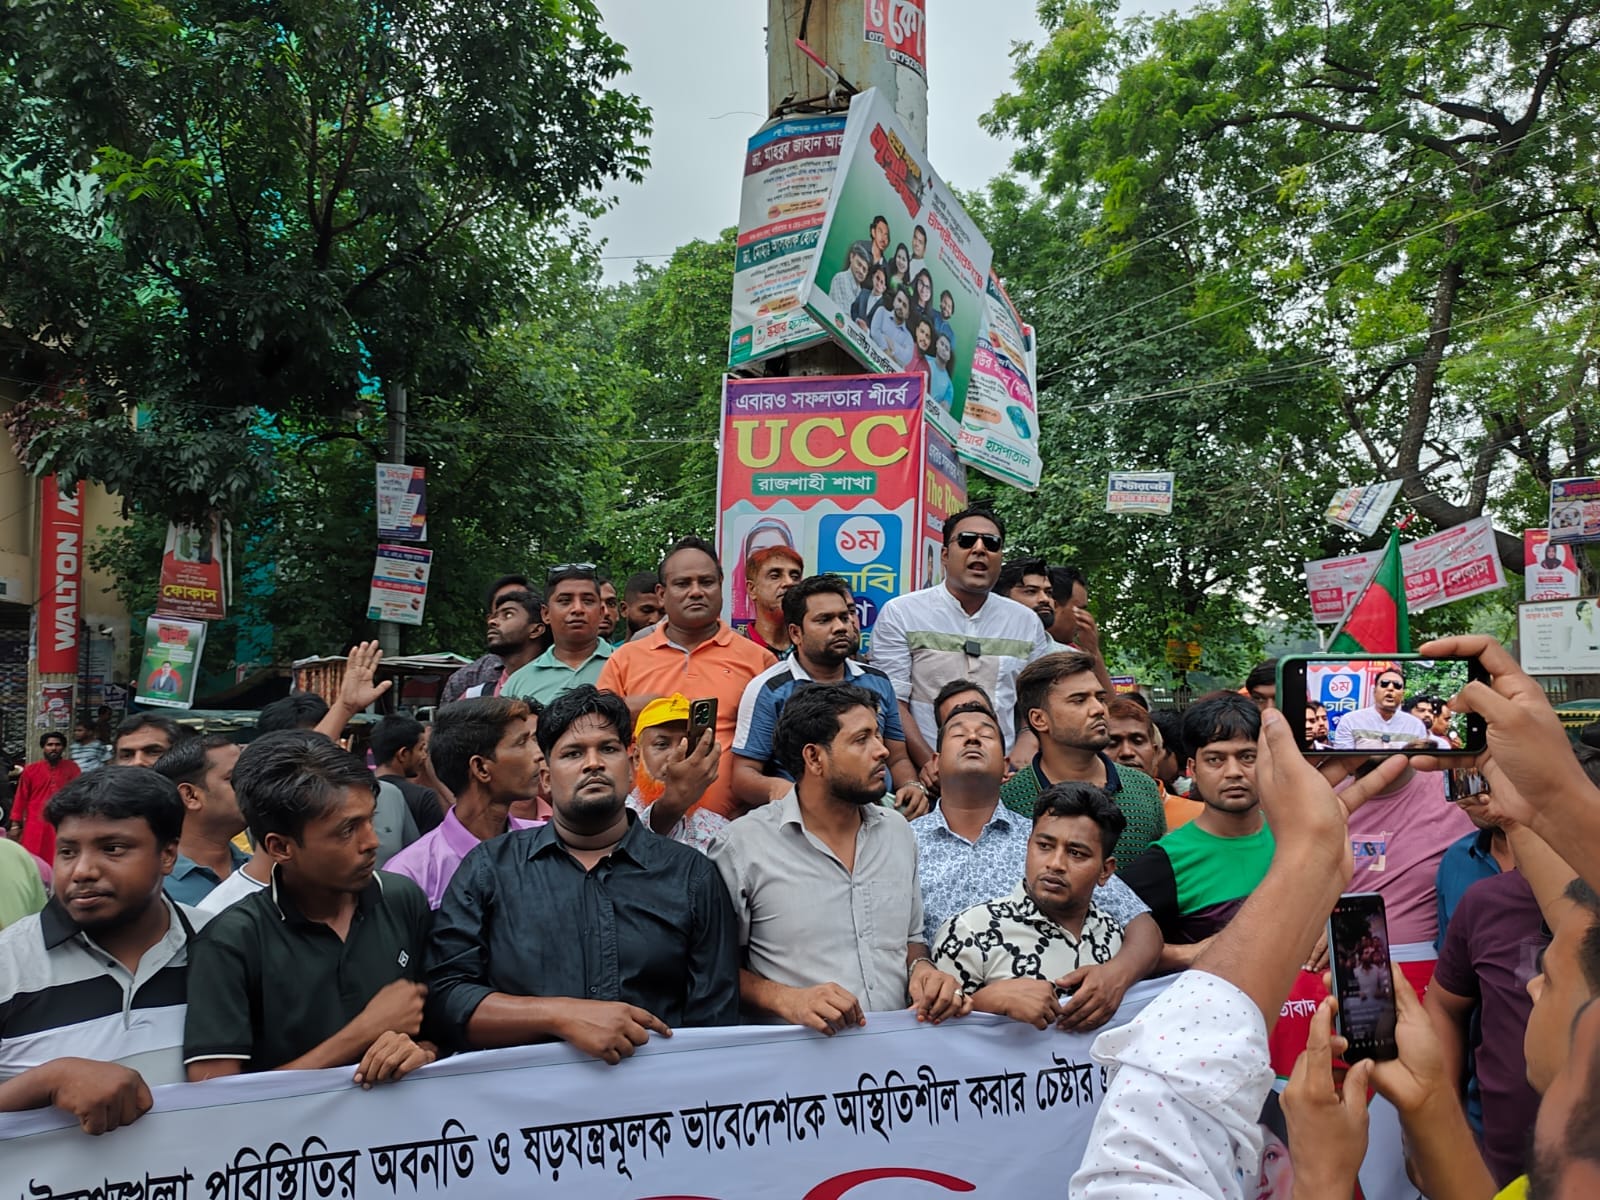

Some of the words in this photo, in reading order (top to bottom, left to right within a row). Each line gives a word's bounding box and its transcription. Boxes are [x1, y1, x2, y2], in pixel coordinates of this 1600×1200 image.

[792, 135, 823, 153] জাহান
[736, 392, 787, 411] এবারও
[792, 388, 863, 409] সফলতার
[868, 381, 910, 406] শীর্ষে
[733, 415, 910, 469] UCC
[757, 472, 827, 491] রাজশাহী
[832, 475, 874, 492] শাখা
[840, 530, 880, 551] ১ম
[55, 532, 78, 651] WALTON
[163, 584, 218, 602] ফোকাস
[1331, 681, 1350, 692] ১ম
[205, 1136, 362, 1200] পরিস্থিতির
[368, 1118, 479, 1195] অবনতি
[488, 1132, 510, 1174] ও
[520, 1112, 674, 1182] ষড়যন্ত্রমূলক
[832, 1064, 960, 1143] অস্থিতিশীল
[965, 1068, 1027, 1120] করার
[1036, 1051, 1094, 1111] চেষ্টার
